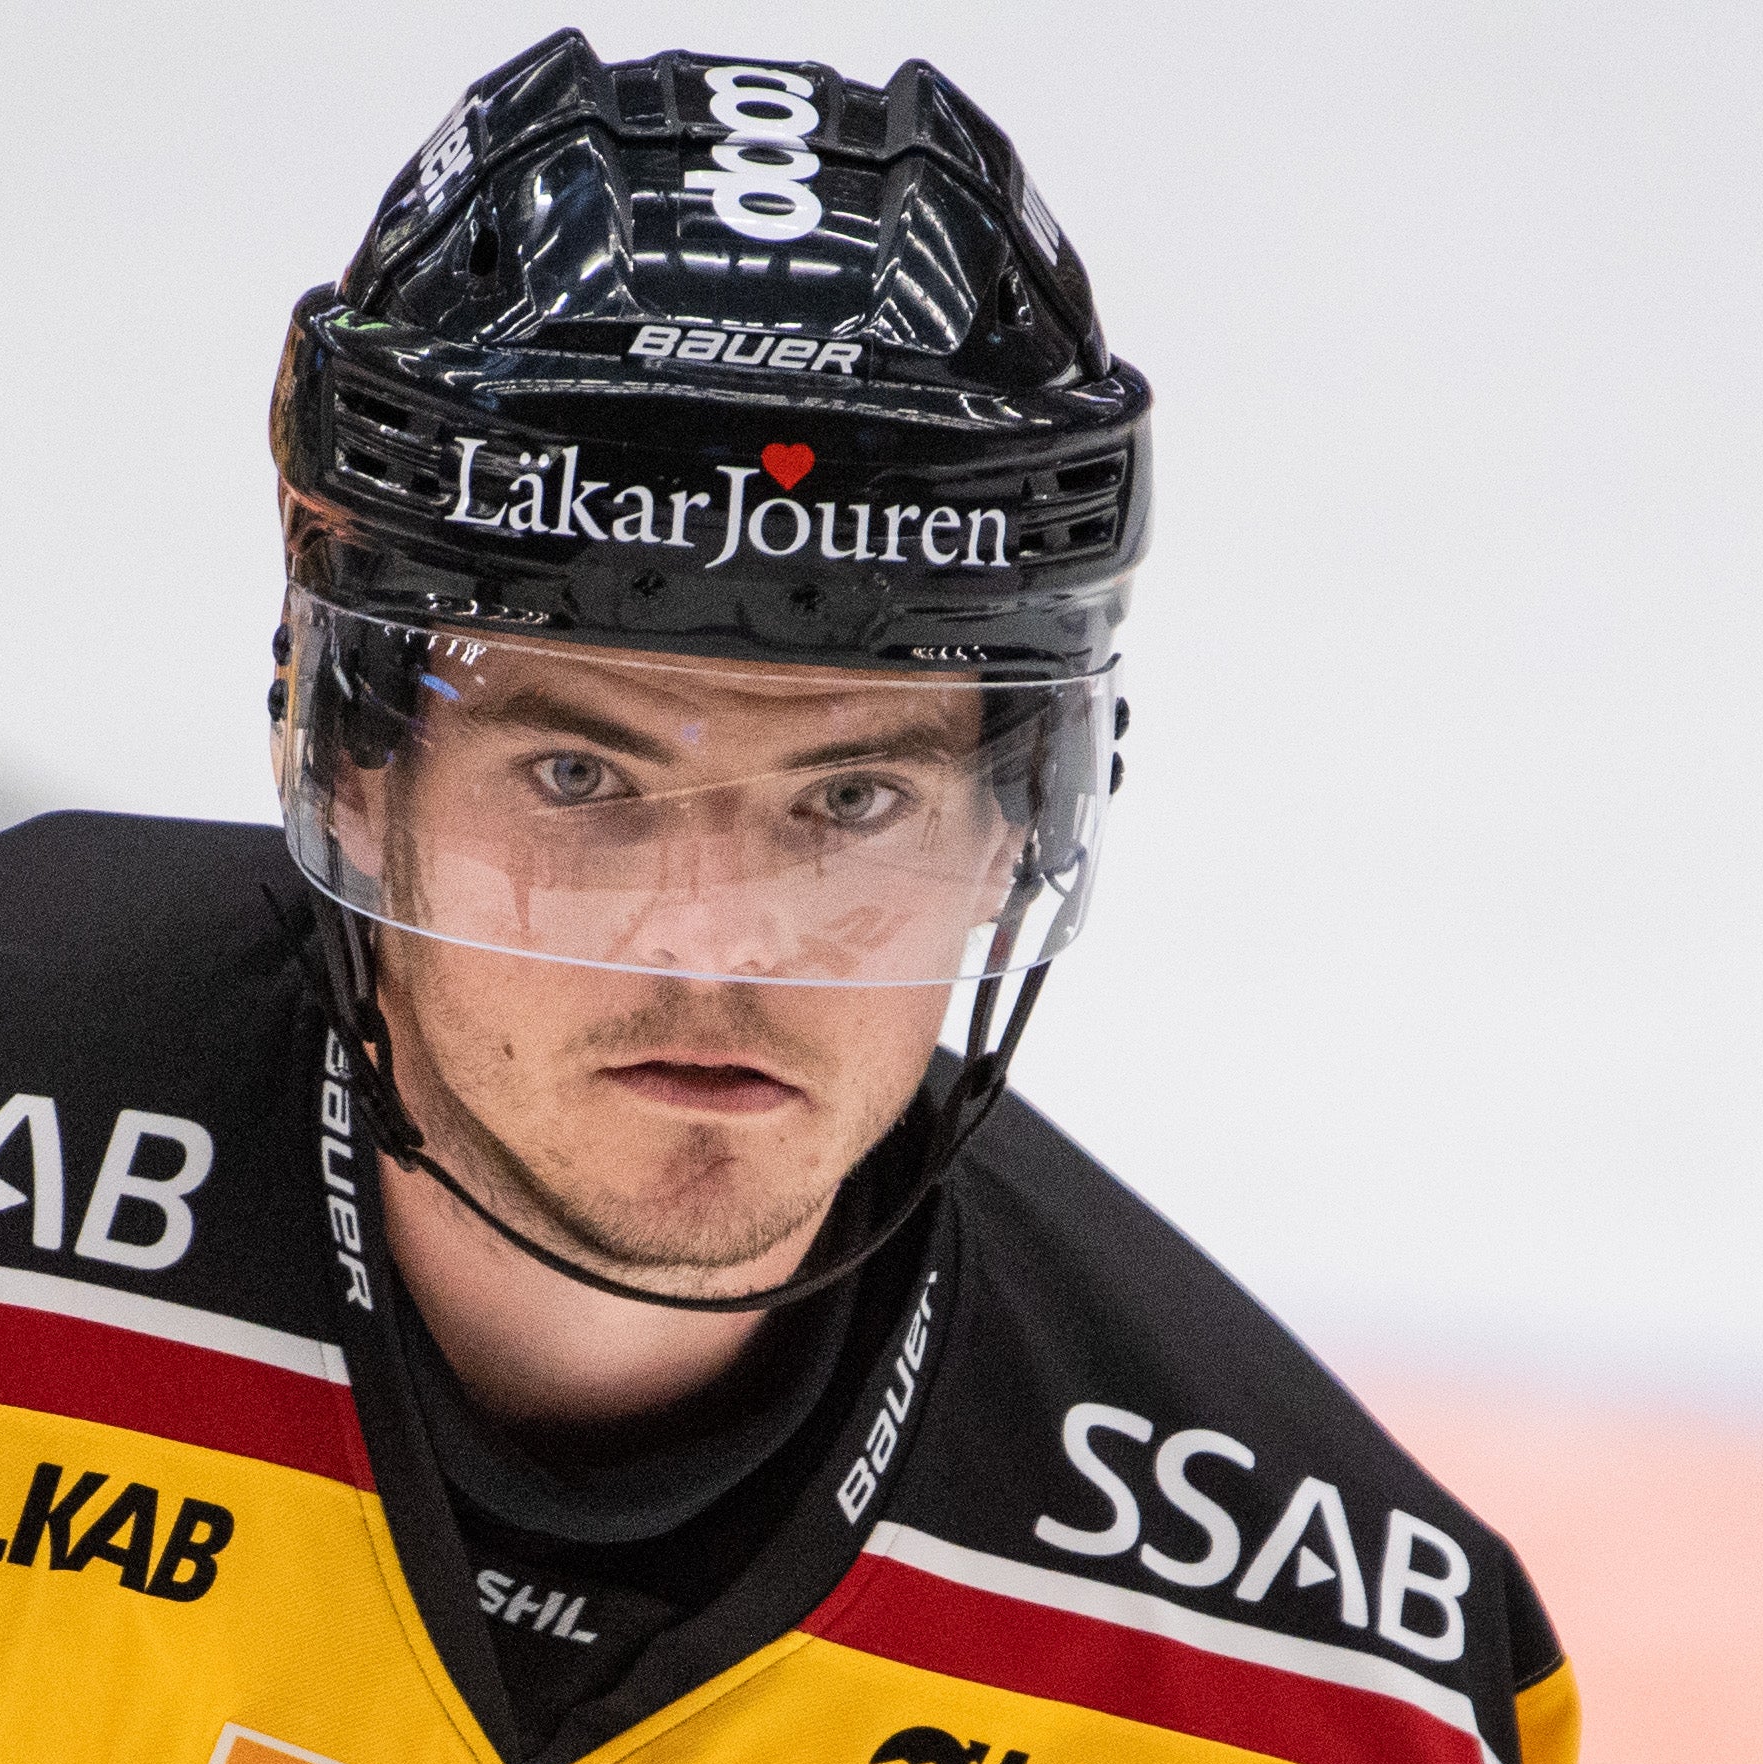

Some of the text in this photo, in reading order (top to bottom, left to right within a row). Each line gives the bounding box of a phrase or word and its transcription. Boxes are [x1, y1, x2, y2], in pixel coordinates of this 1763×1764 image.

[628, 324, 863, 375] BAUER
[444, 436, 1012, 570] LäkarJouren
[1035, 1400, 1472, 1663] SSAB
[476, 1569, 598, 1645] SHL
